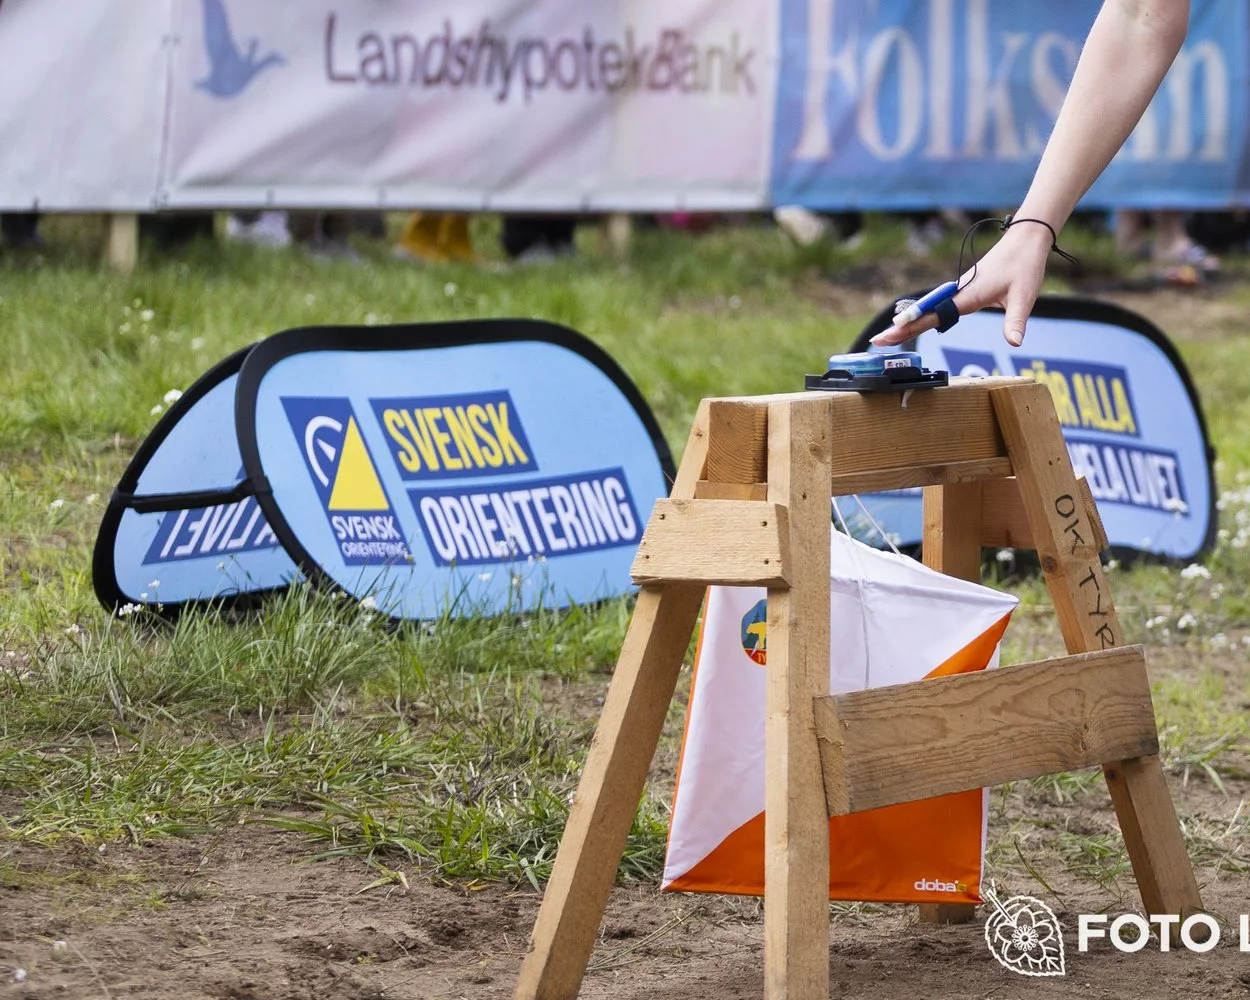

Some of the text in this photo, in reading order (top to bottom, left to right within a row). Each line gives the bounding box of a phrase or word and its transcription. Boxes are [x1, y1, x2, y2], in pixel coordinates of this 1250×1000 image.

[1072, 372, 1136, 435] ALLA
[383, 401, 529, 473] SVENSK
[1121, 447, 1188, 514] LIVET
[331, 515, 401, 540] SVENSK
[341, 541, 408, 558] ORIENTERING
[420, 477, 637, 562] ORIENTERING
[1055, 494, 1085, 555] OK
